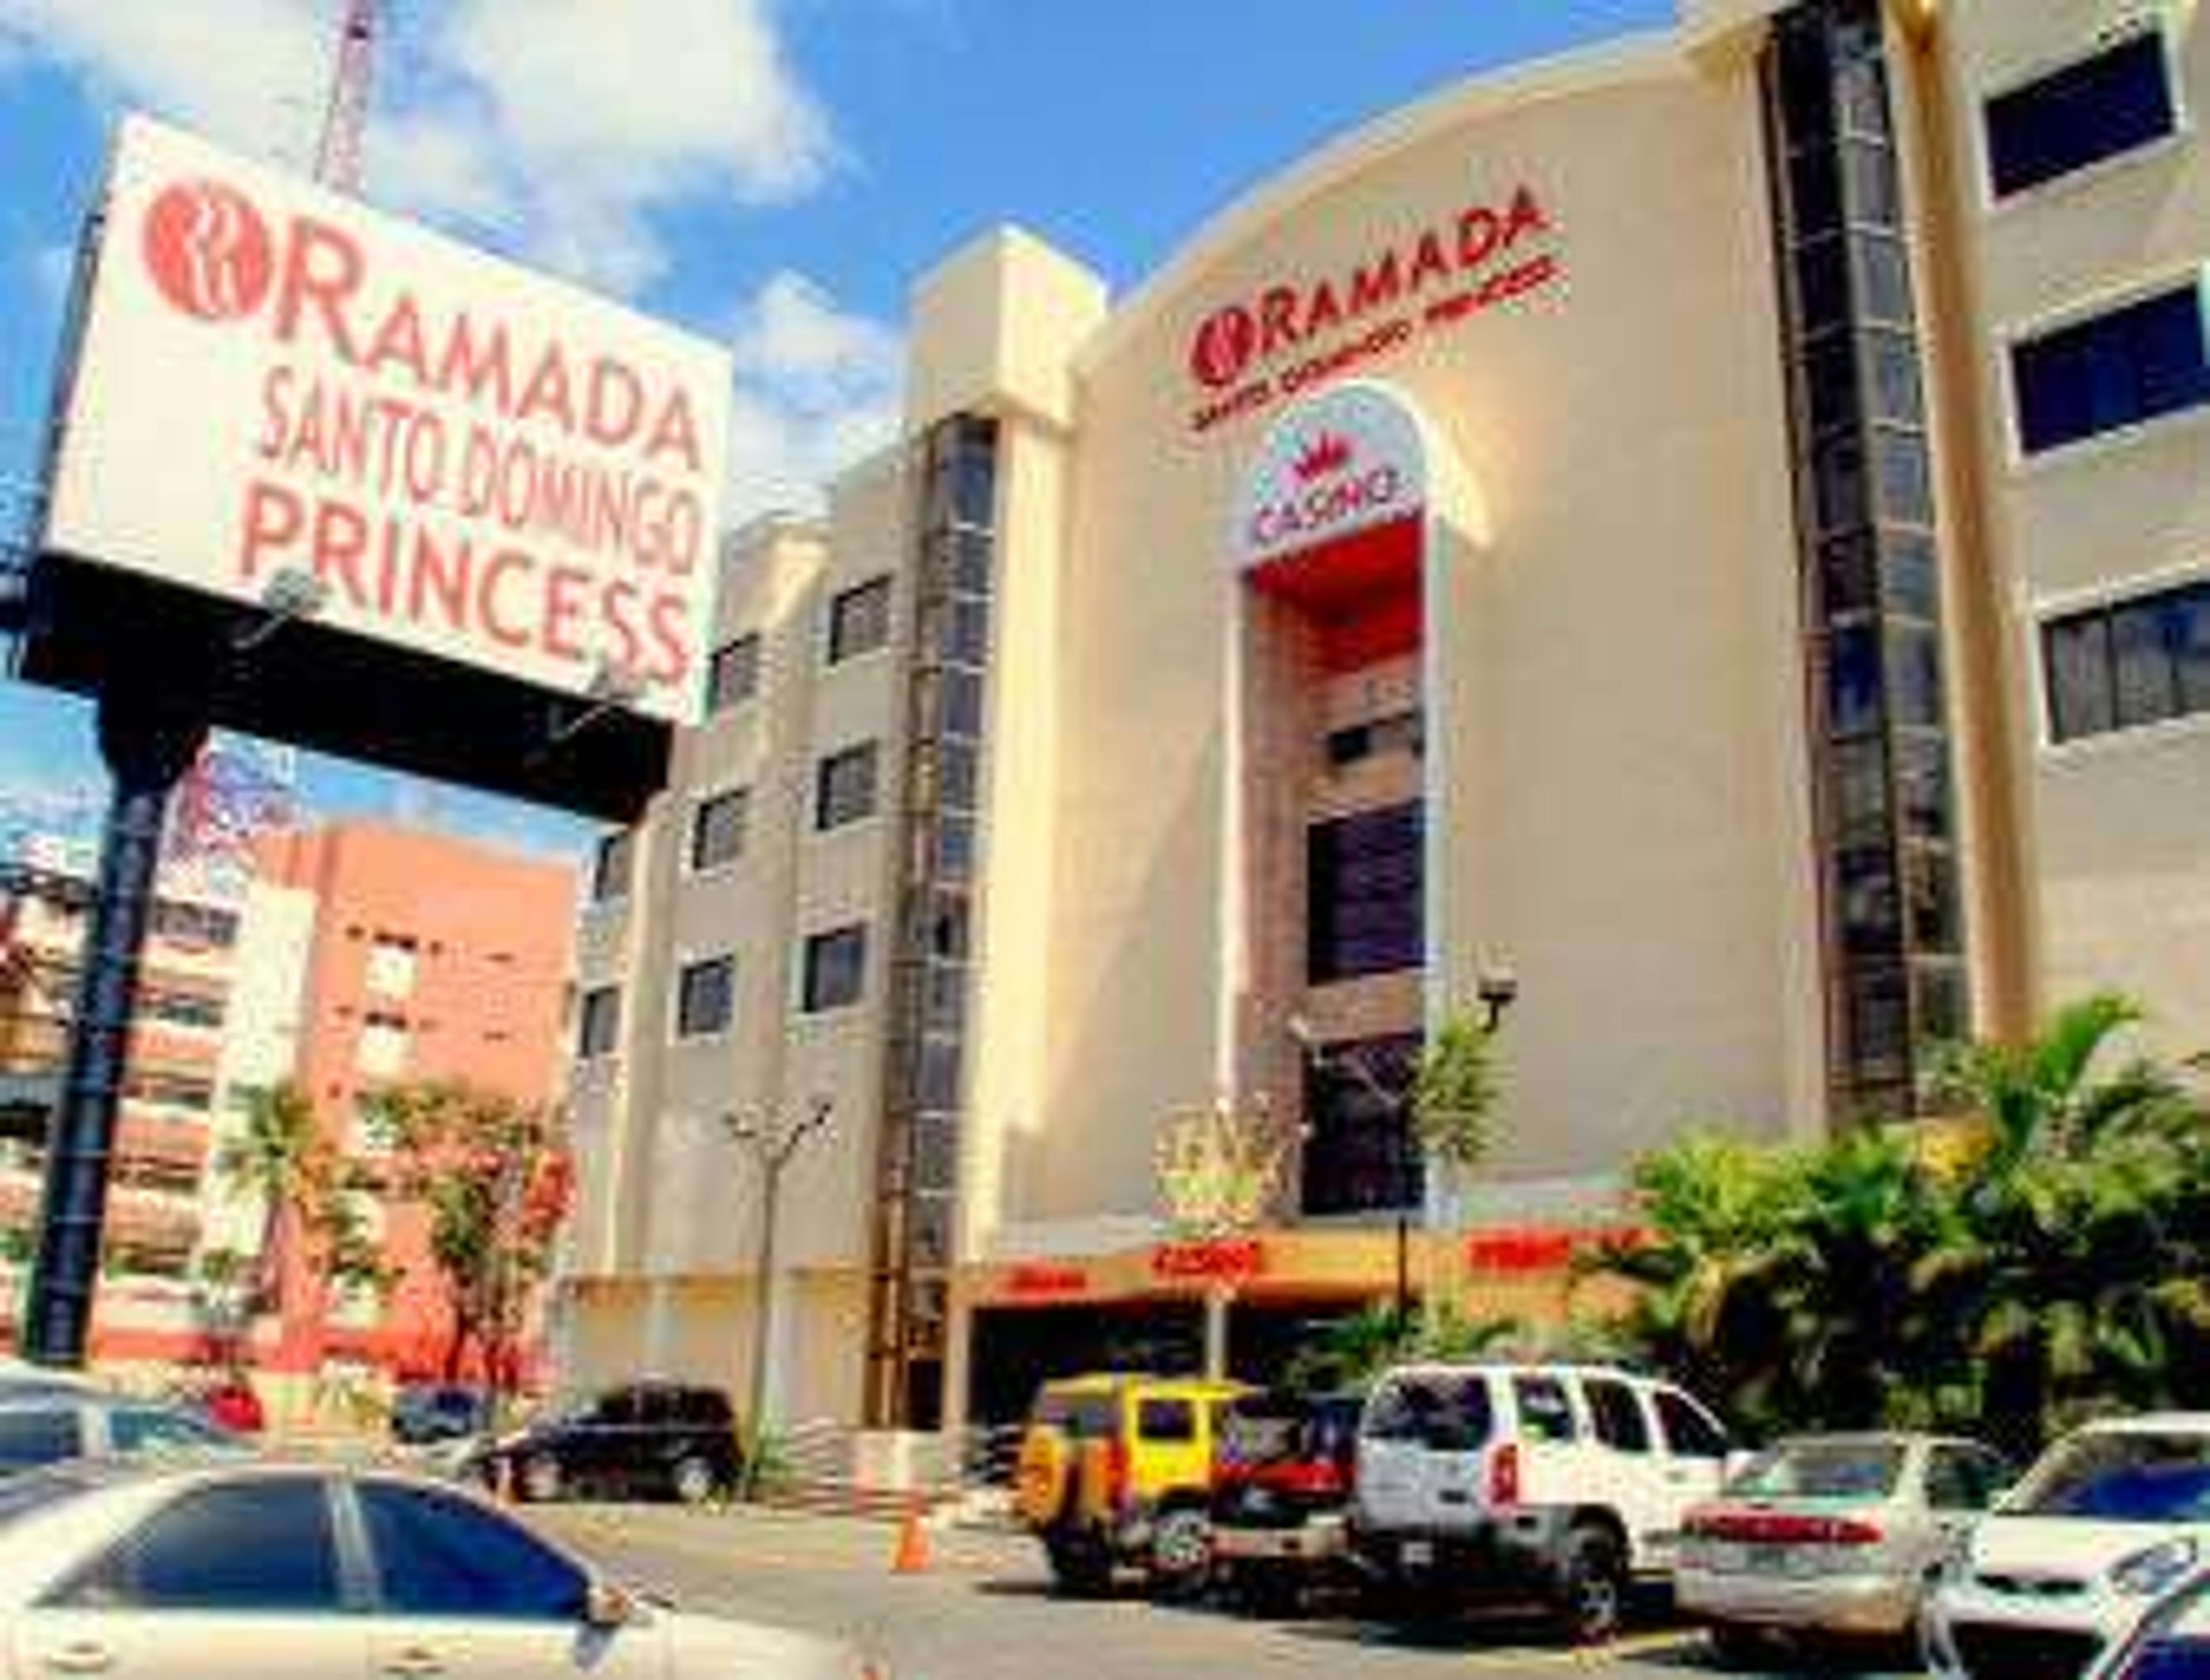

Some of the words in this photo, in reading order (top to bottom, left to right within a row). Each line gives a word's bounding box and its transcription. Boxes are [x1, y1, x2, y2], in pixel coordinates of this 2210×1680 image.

[270, 214, 701, 471] RAMADA
[1262, 185, 1549, 351] RAMADA
[259, 364, 443, 504] SANTO
[459, 419, 701, 576] DOMINGO
[237, 481, 692, 687] PRINCESS
